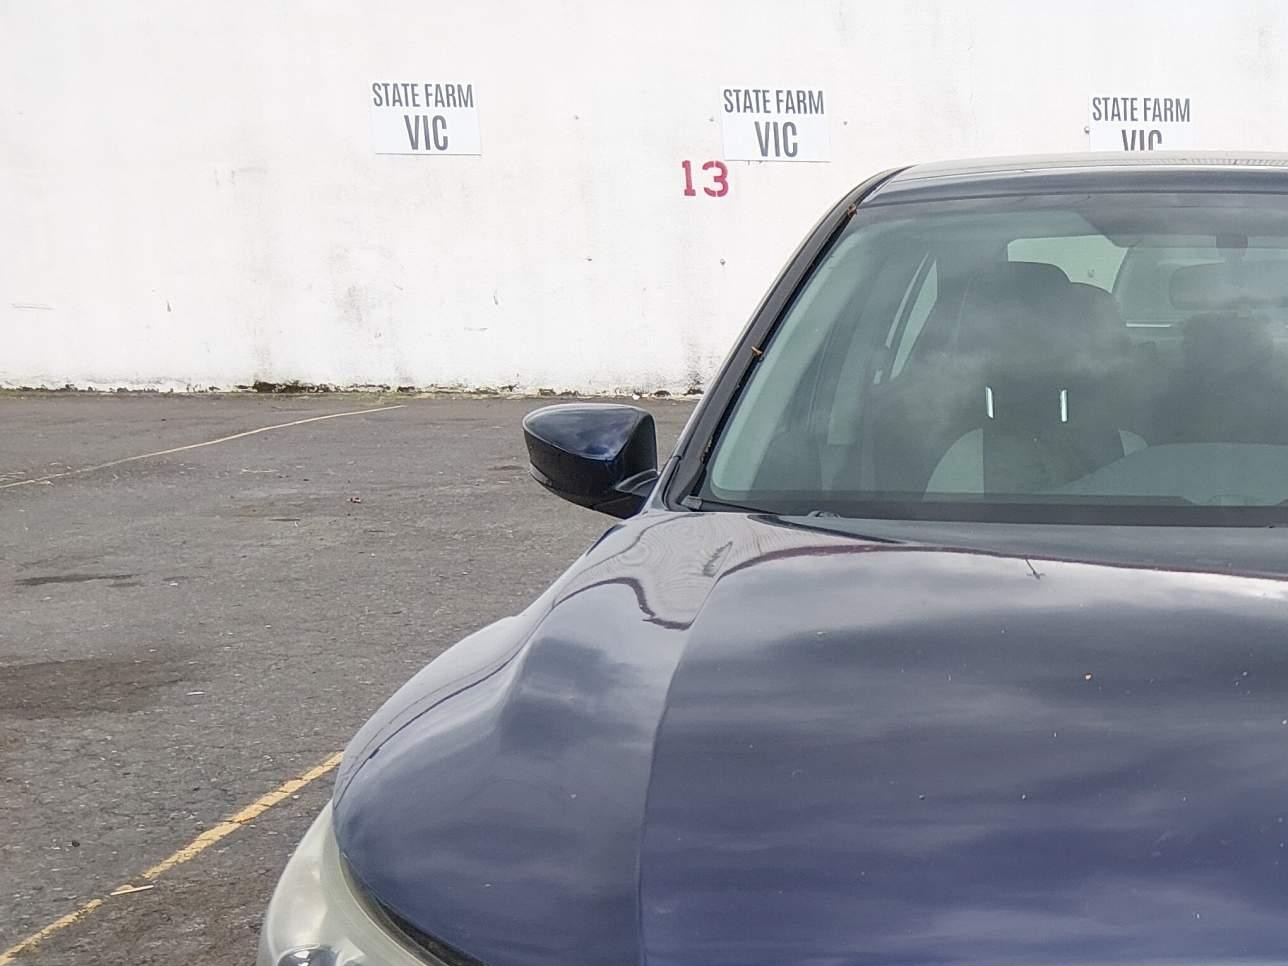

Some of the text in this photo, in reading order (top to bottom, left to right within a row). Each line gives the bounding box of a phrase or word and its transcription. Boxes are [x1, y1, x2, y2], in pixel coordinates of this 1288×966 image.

[373, 83, 474, 108] STATE FARM
[724, 89, 824, 114] STATE FARM
[1092, 97, 1190, 122] STATE FARM
[404, 115, 448, 150] VIC
[755, 122, 798, 157] VIC
[682, 160, 730, 198] 13
